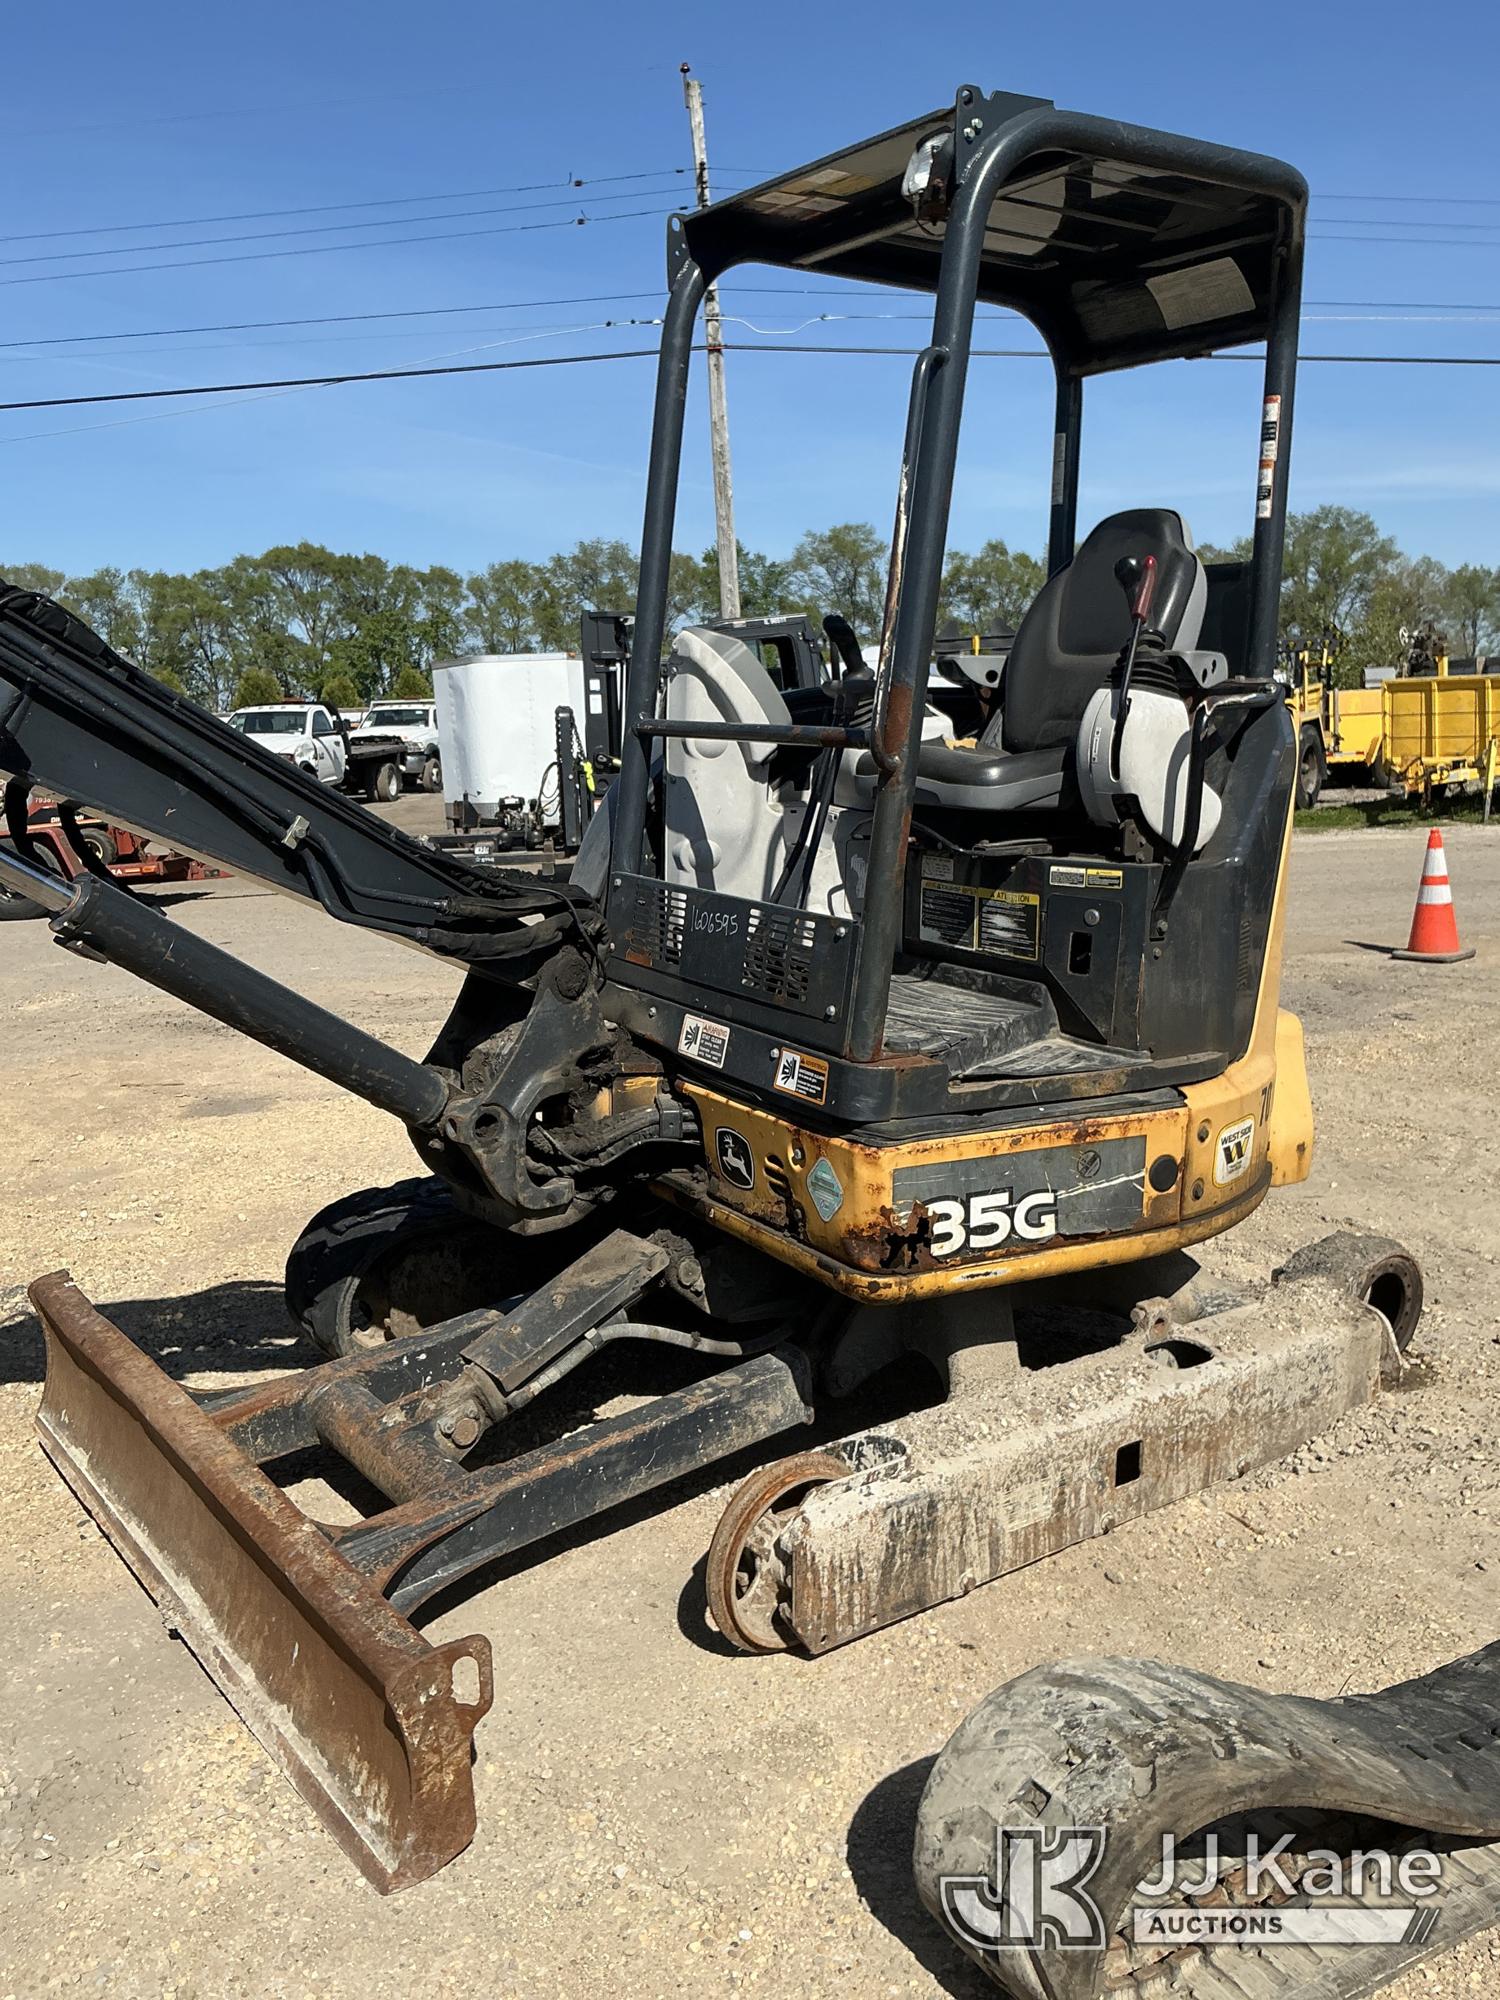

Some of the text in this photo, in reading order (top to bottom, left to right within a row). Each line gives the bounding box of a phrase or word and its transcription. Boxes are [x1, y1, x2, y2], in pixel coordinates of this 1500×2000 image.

[691, 905, 738, 936] 1606595
[1221, 1130, 1240, 1145] WEST
[924, 1190, 1057, 1257] 35G
